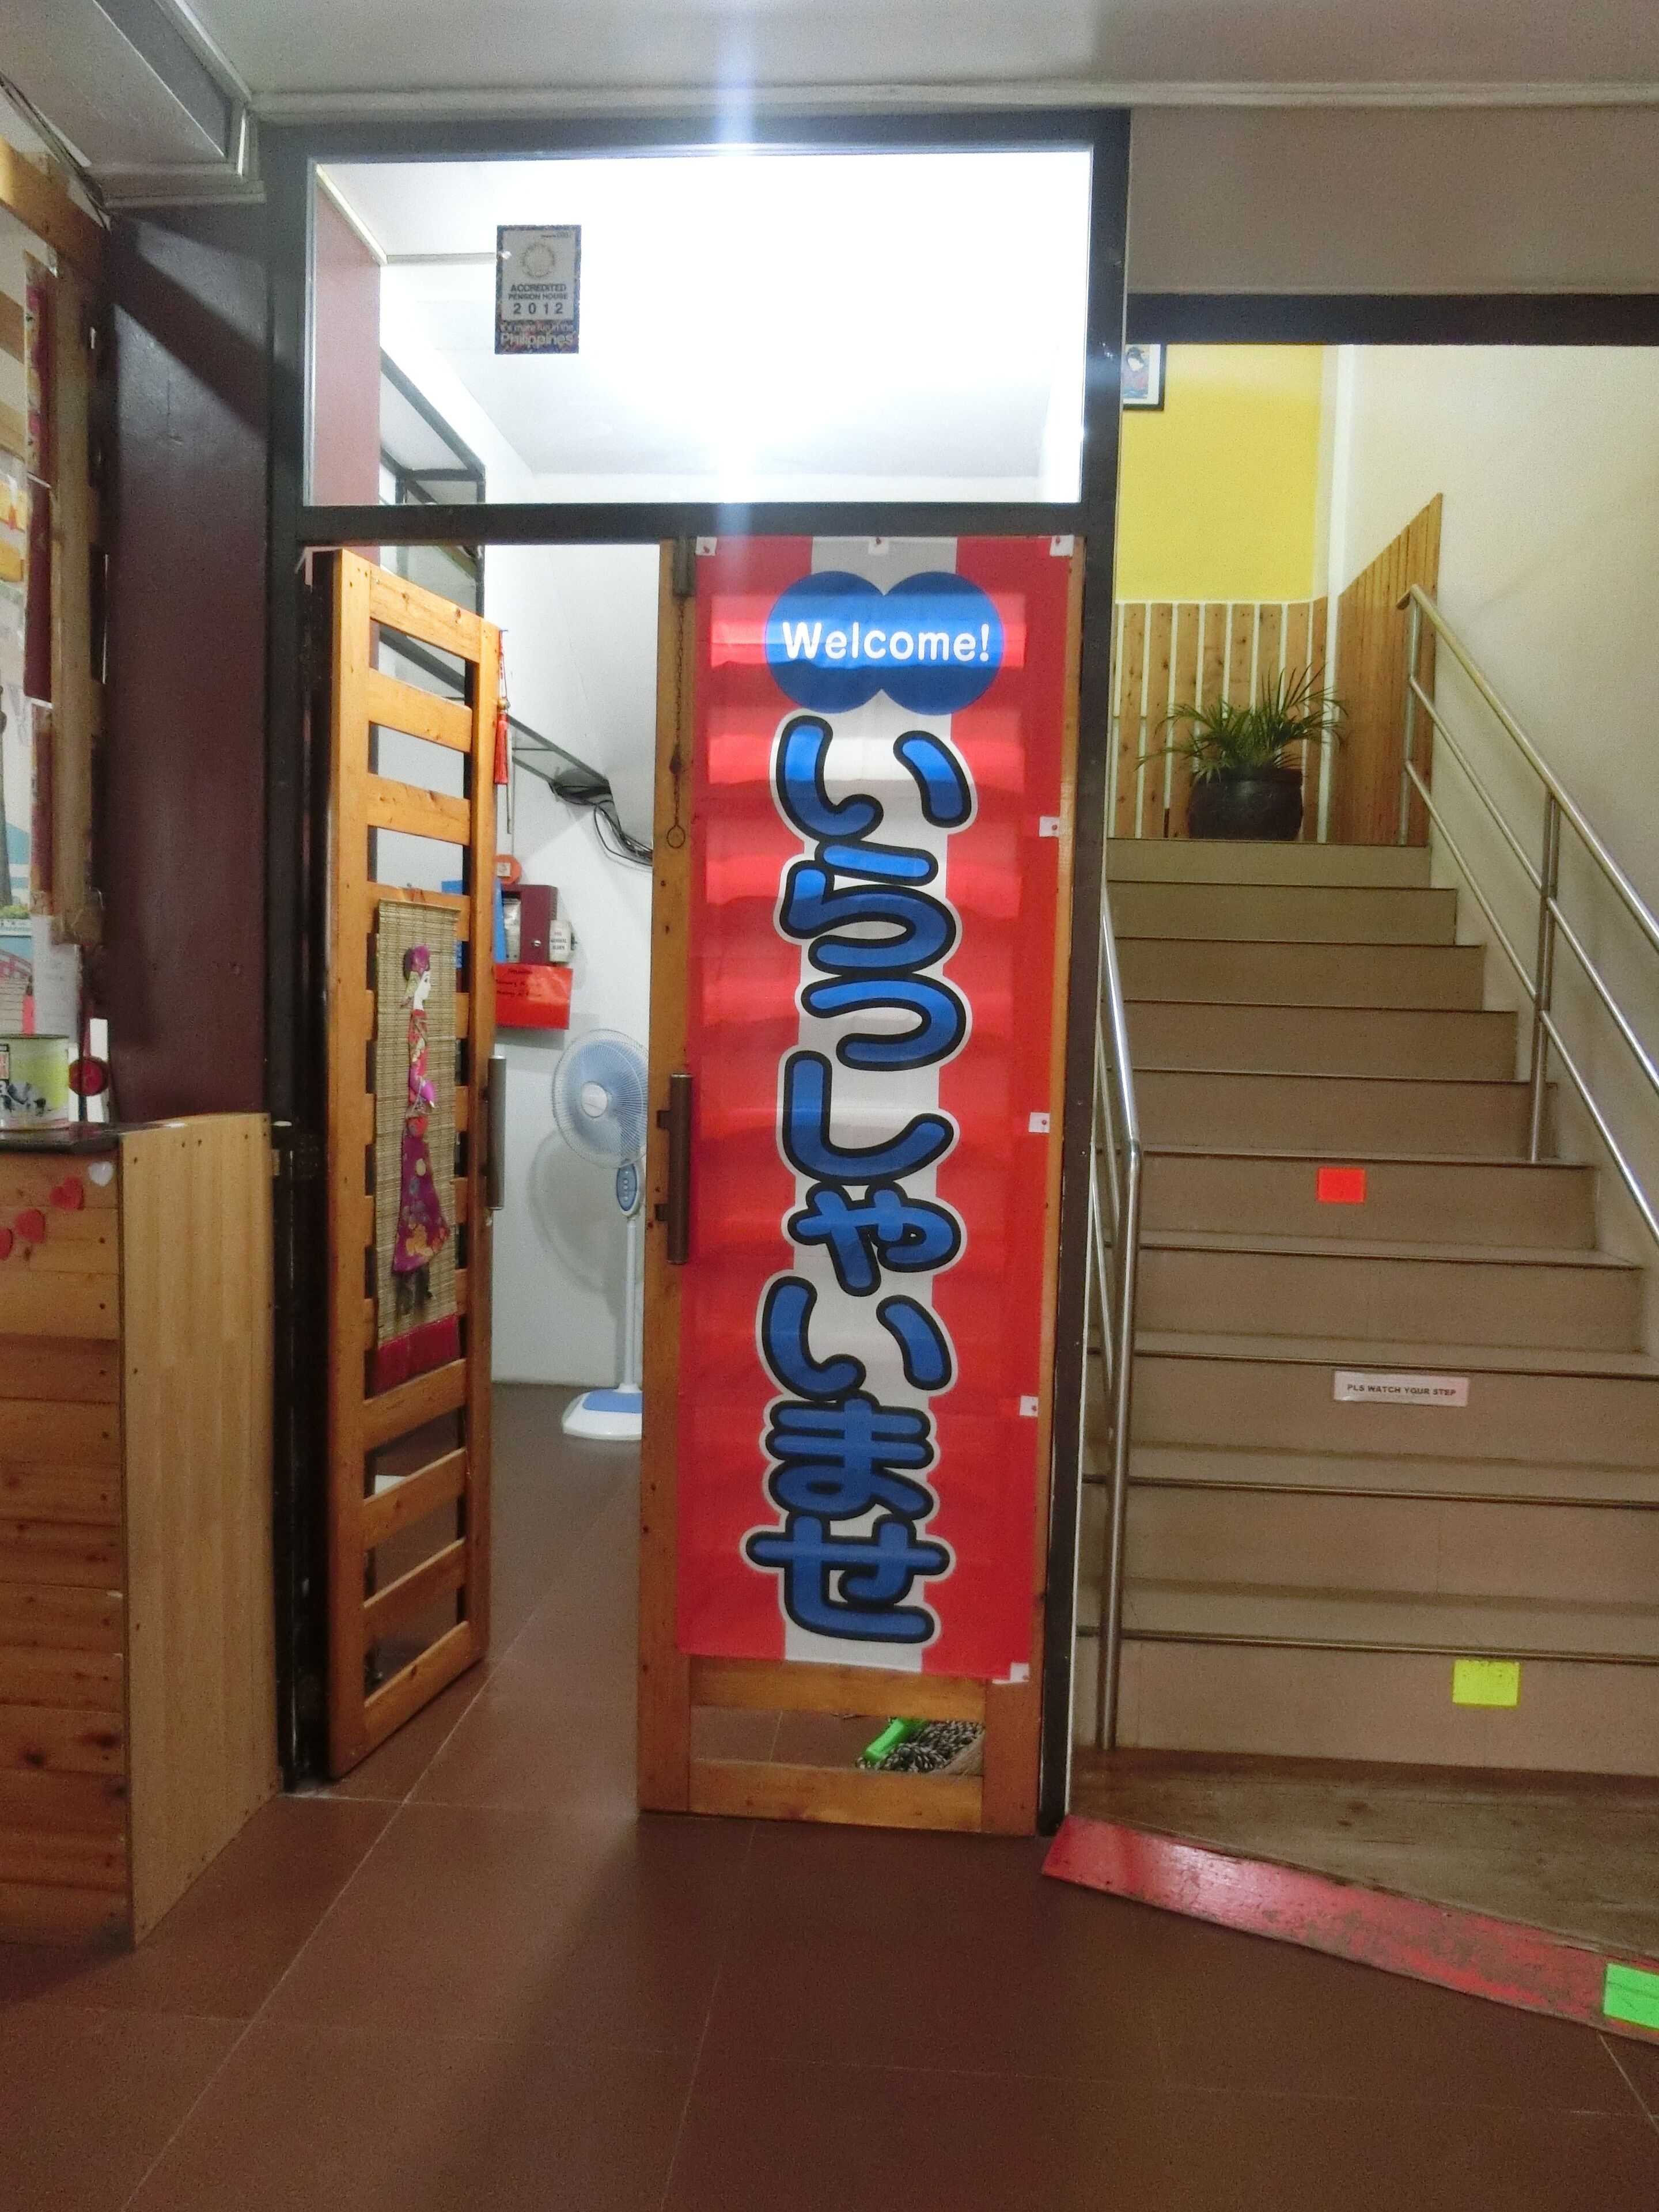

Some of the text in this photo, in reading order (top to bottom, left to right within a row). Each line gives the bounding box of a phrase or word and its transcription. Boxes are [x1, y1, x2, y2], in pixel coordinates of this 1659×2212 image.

[511, 283, 566, 292] ACCREDITED
[513, 302, 563, 315] 2012
[500, 332, 574, 349] Philippines
[782, 622, 990, 662] Welcome!
[746, 714, 972, 1643] いらっしゃいませ
[1368, 1385, 1400, 1393] WATCH
